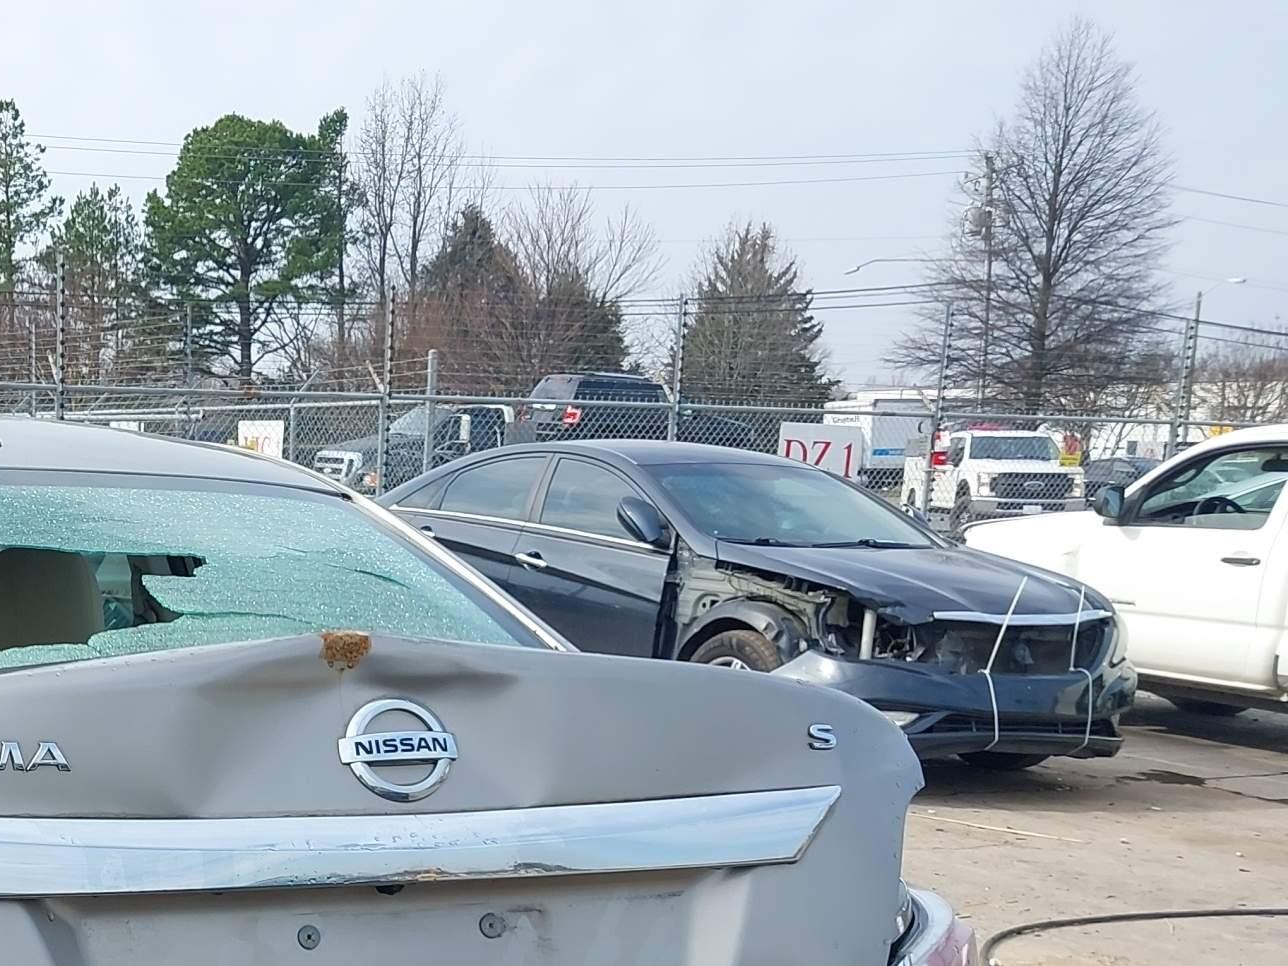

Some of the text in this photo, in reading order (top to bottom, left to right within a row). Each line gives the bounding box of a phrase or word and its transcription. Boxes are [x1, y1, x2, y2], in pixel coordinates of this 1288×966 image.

[783, 438, 853, 479] DZ 1
[354, 737, 449, 756] NISSAN
[808, 723, 837, 750] S
